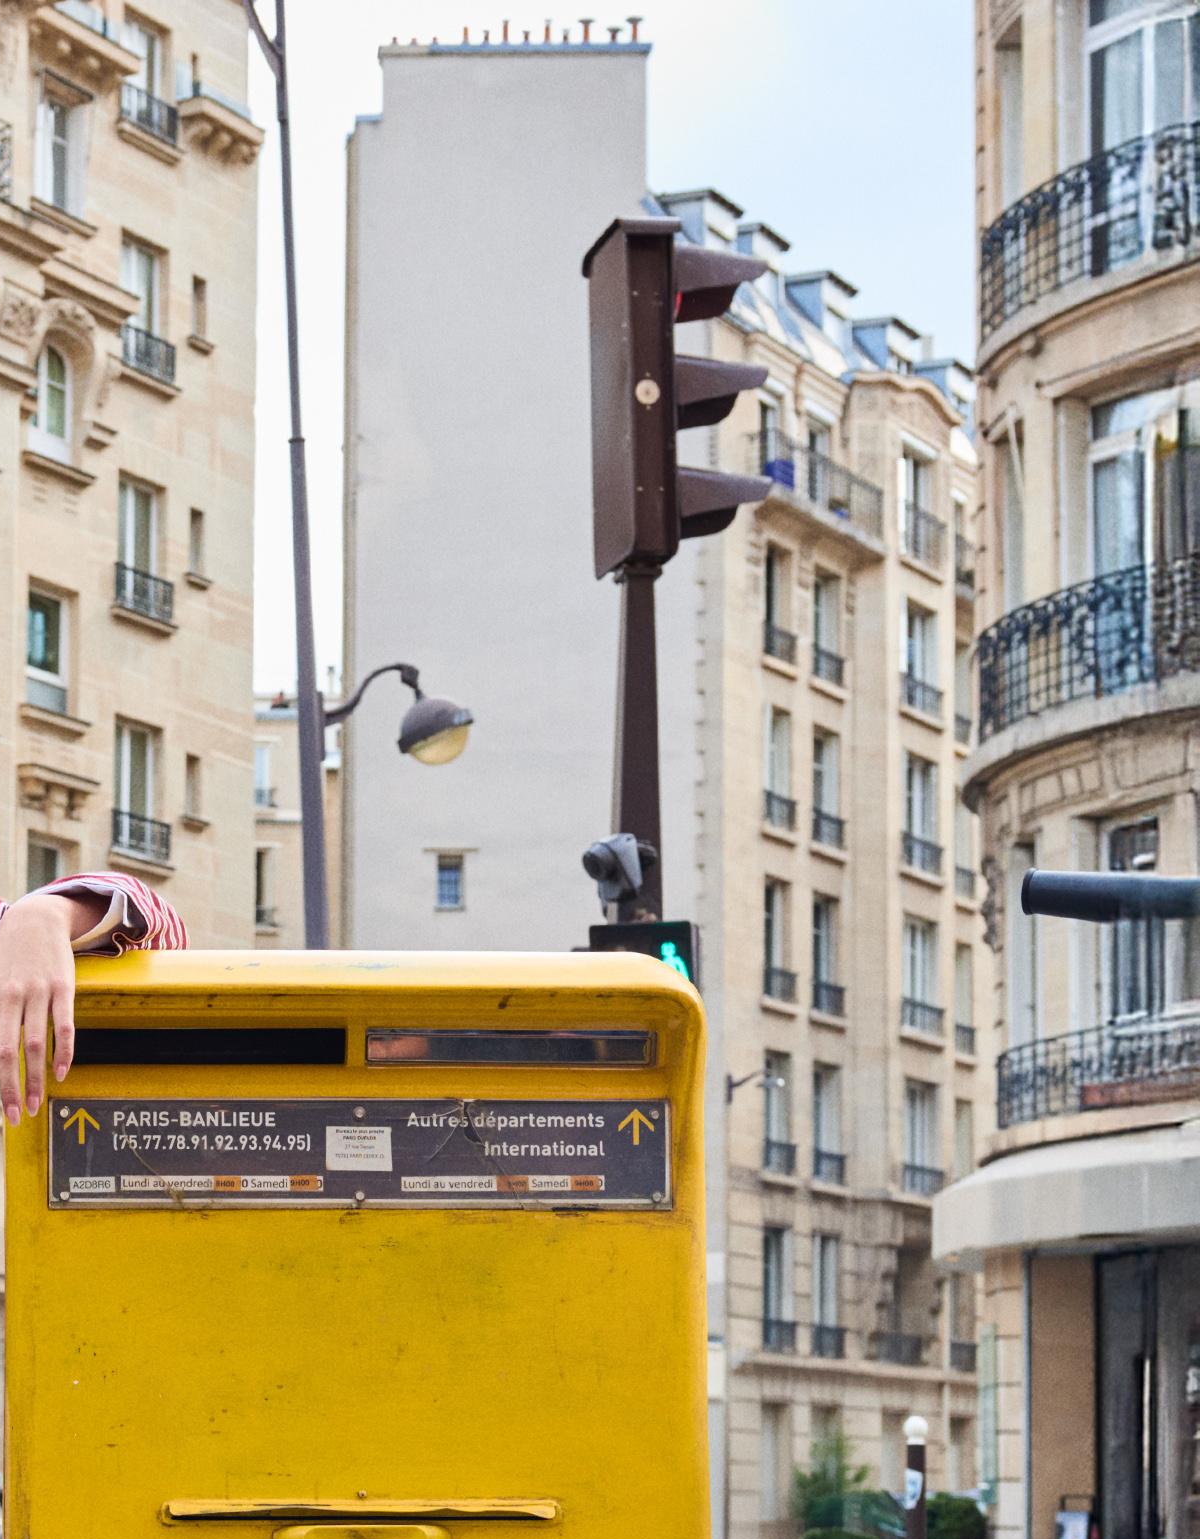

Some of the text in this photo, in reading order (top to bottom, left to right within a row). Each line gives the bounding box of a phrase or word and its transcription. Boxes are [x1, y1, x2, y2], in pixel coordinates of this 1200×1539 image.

[113, 1111, 276, 1127] PARIS-BANLIEUE
[407, 1111, 605, 1130] Autres départements
[113, 1134, 311, 1152] (75.77.78.91.92.93.94.95)
[484, 1141, 605, 1156] International
[73, 1180, 111, 1189] A2D8R6
[123, 1178, 150, 1188] Lundi
[168, 1178, 212, 1188] vendredi
[251, 1178, 288, 1188] Samedi
[403, 1179, 431, 1188] Lundi
[448, 1179, 493, 1188] vendredi
[532, 1179, 568, 1188] Samedi
